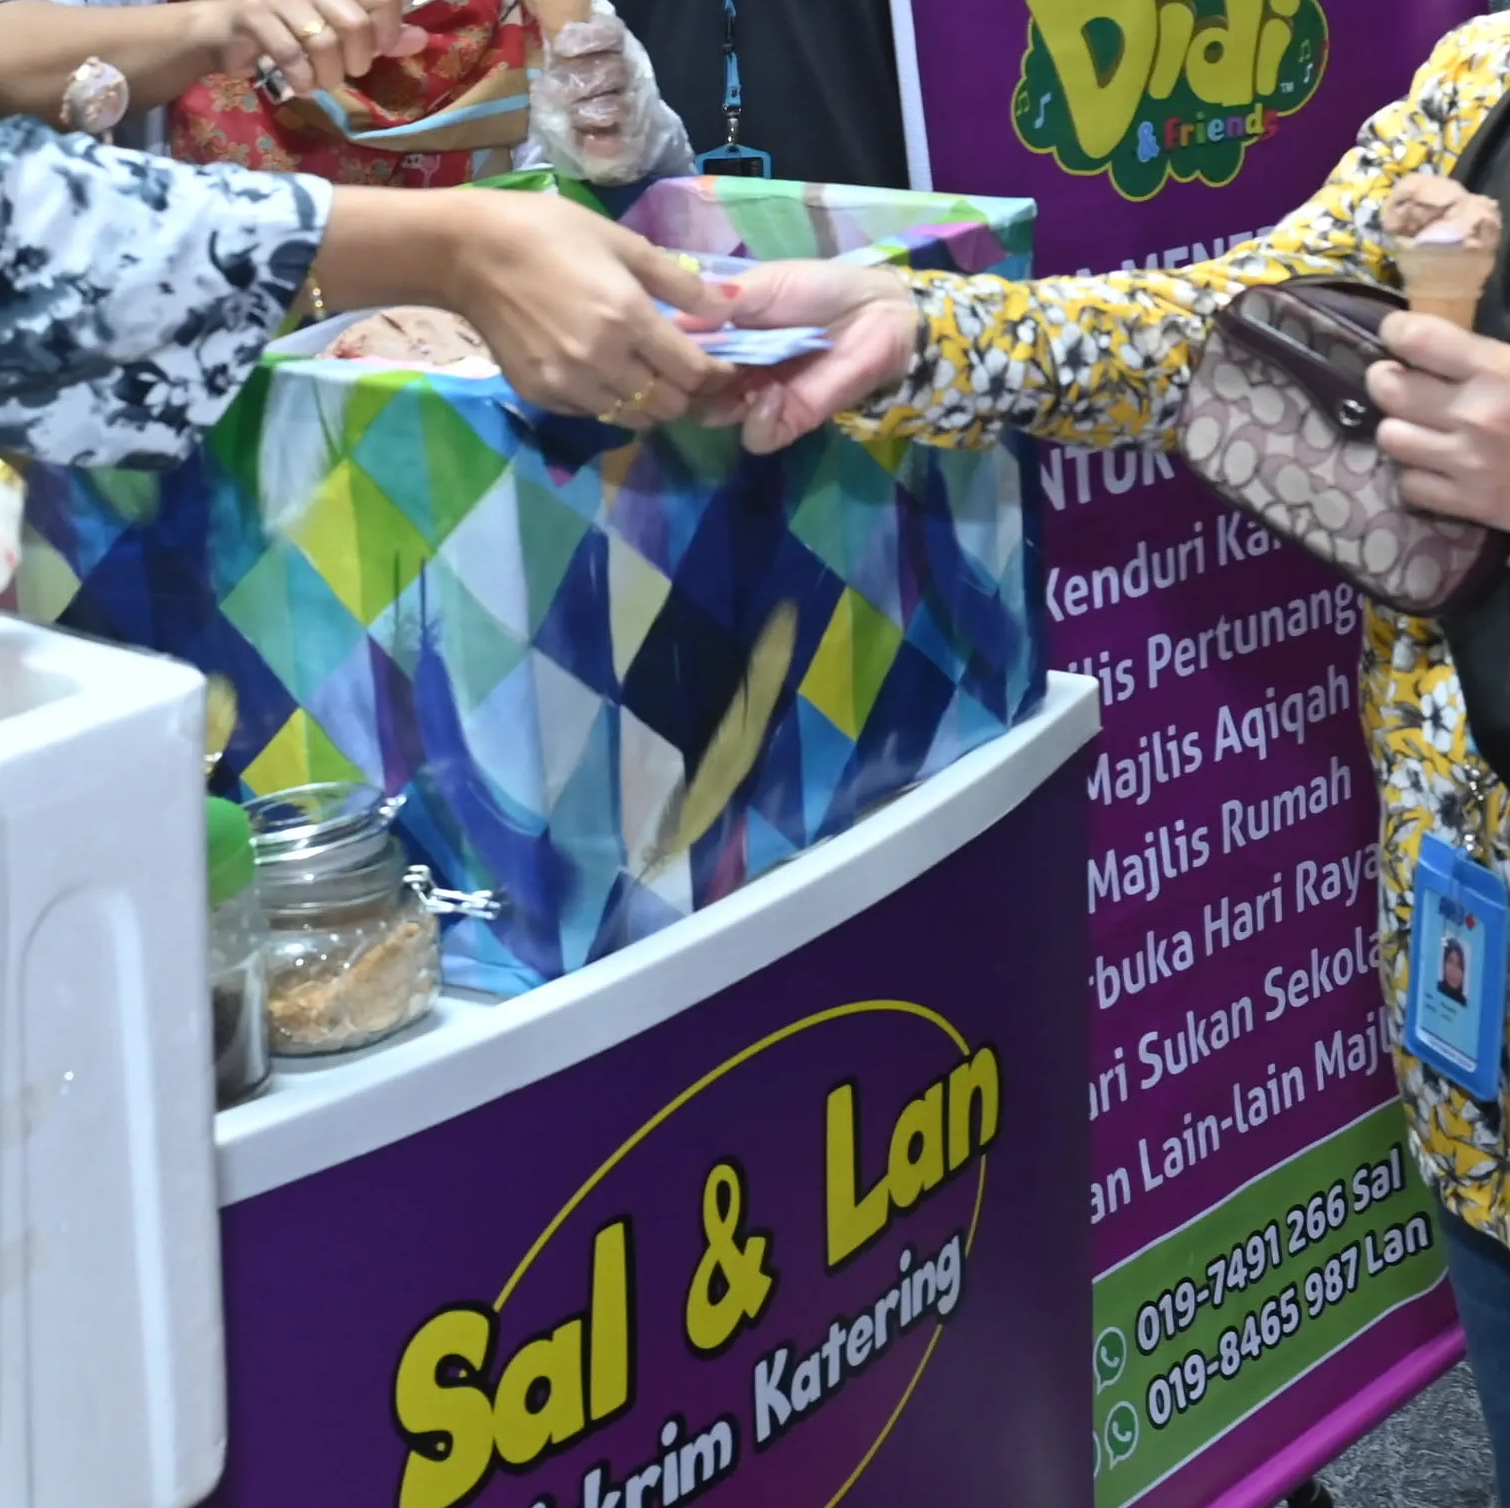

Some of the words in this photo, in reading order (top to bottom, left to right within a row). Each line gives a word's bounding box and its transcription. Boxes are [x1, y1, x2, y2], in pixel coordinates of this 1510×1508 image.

[1136, 120, 1160, 163] &
[1217, 511, 1281, 566] Ka
[1148, 582, 1363, 689] Pertunang
[1087, 723, 1203, 807] Majlis
[1213, 665, 1350, 762] Aqiqah
[1087, 818, 1210, 915] Majlis
[1221, 756, 1352, 854] Rumah
[1089, 930, 1195, 1010] buka
[1203, 872, 1283, 957] Hari
[1295, 842, 1380, 913] Raya
[1138, 996, 1254, 1090] Sukan
[1138, 1063, 1306, 1192] Lain-lain
[395, 1220, 629, 1508] Sal
[684, 1162, 773, 1350] &
[825, 1046, 999, 1267] Lan
[1138, 1224, 1281, 1351] 019-7491
[1287, 1184, 1346, 1254] 266
[1352, 1147, 1402, 1212] Sal
[1148, 1288, 1299, 1425] 019-8465
[1304, 1245, 1358, 1317] 987
[1364, 1216, 1429, 1275] Lan
[754, 1233, 961, 1443] Katering
